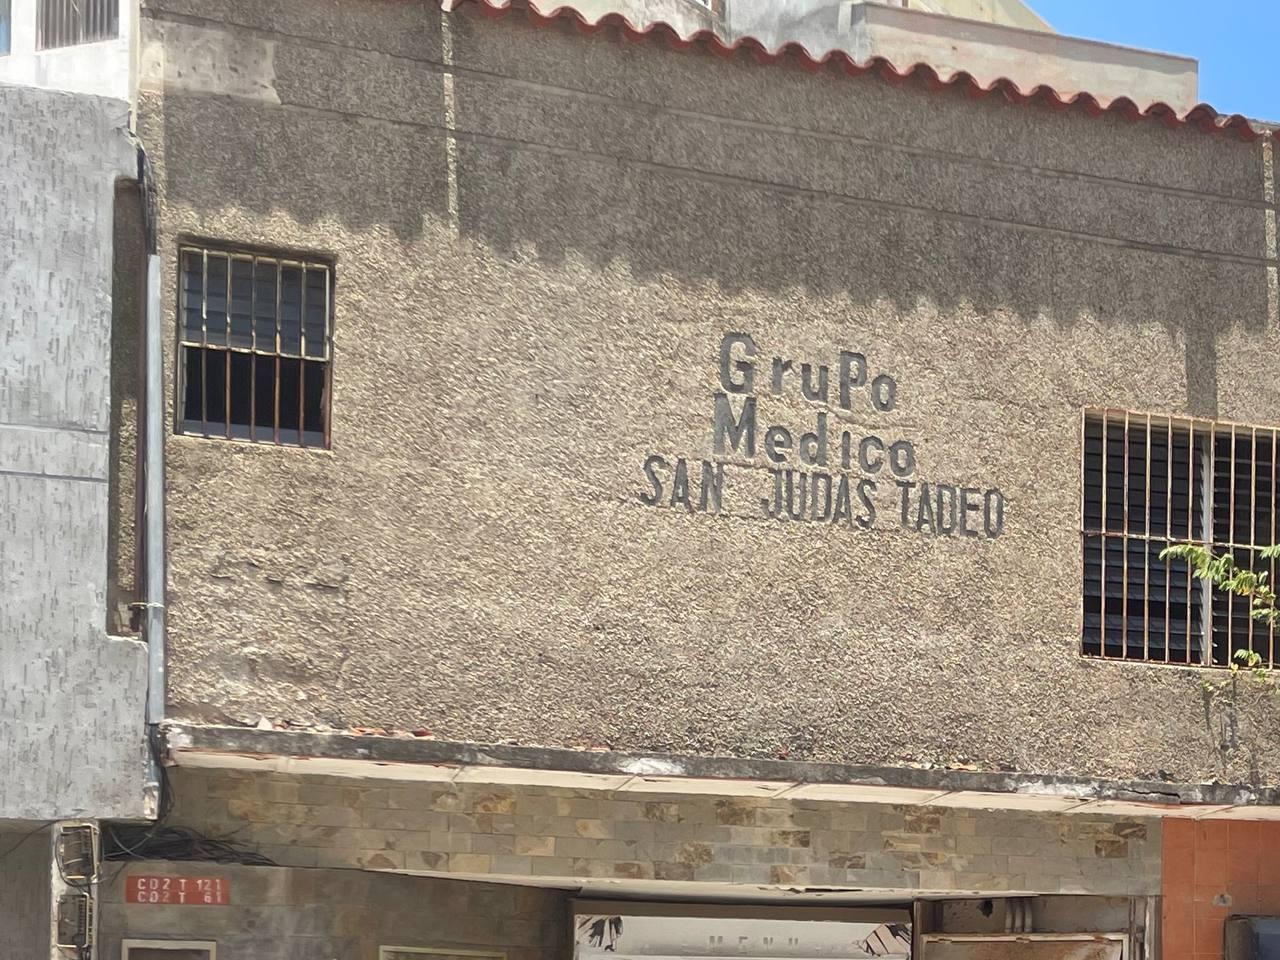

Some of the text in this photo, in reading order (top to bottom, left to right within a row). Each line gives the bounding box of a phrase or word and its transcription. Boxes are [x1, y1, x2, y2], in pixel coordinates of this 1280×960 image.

[640, 455, 1005, 539] SAN JUDAS TADEO
